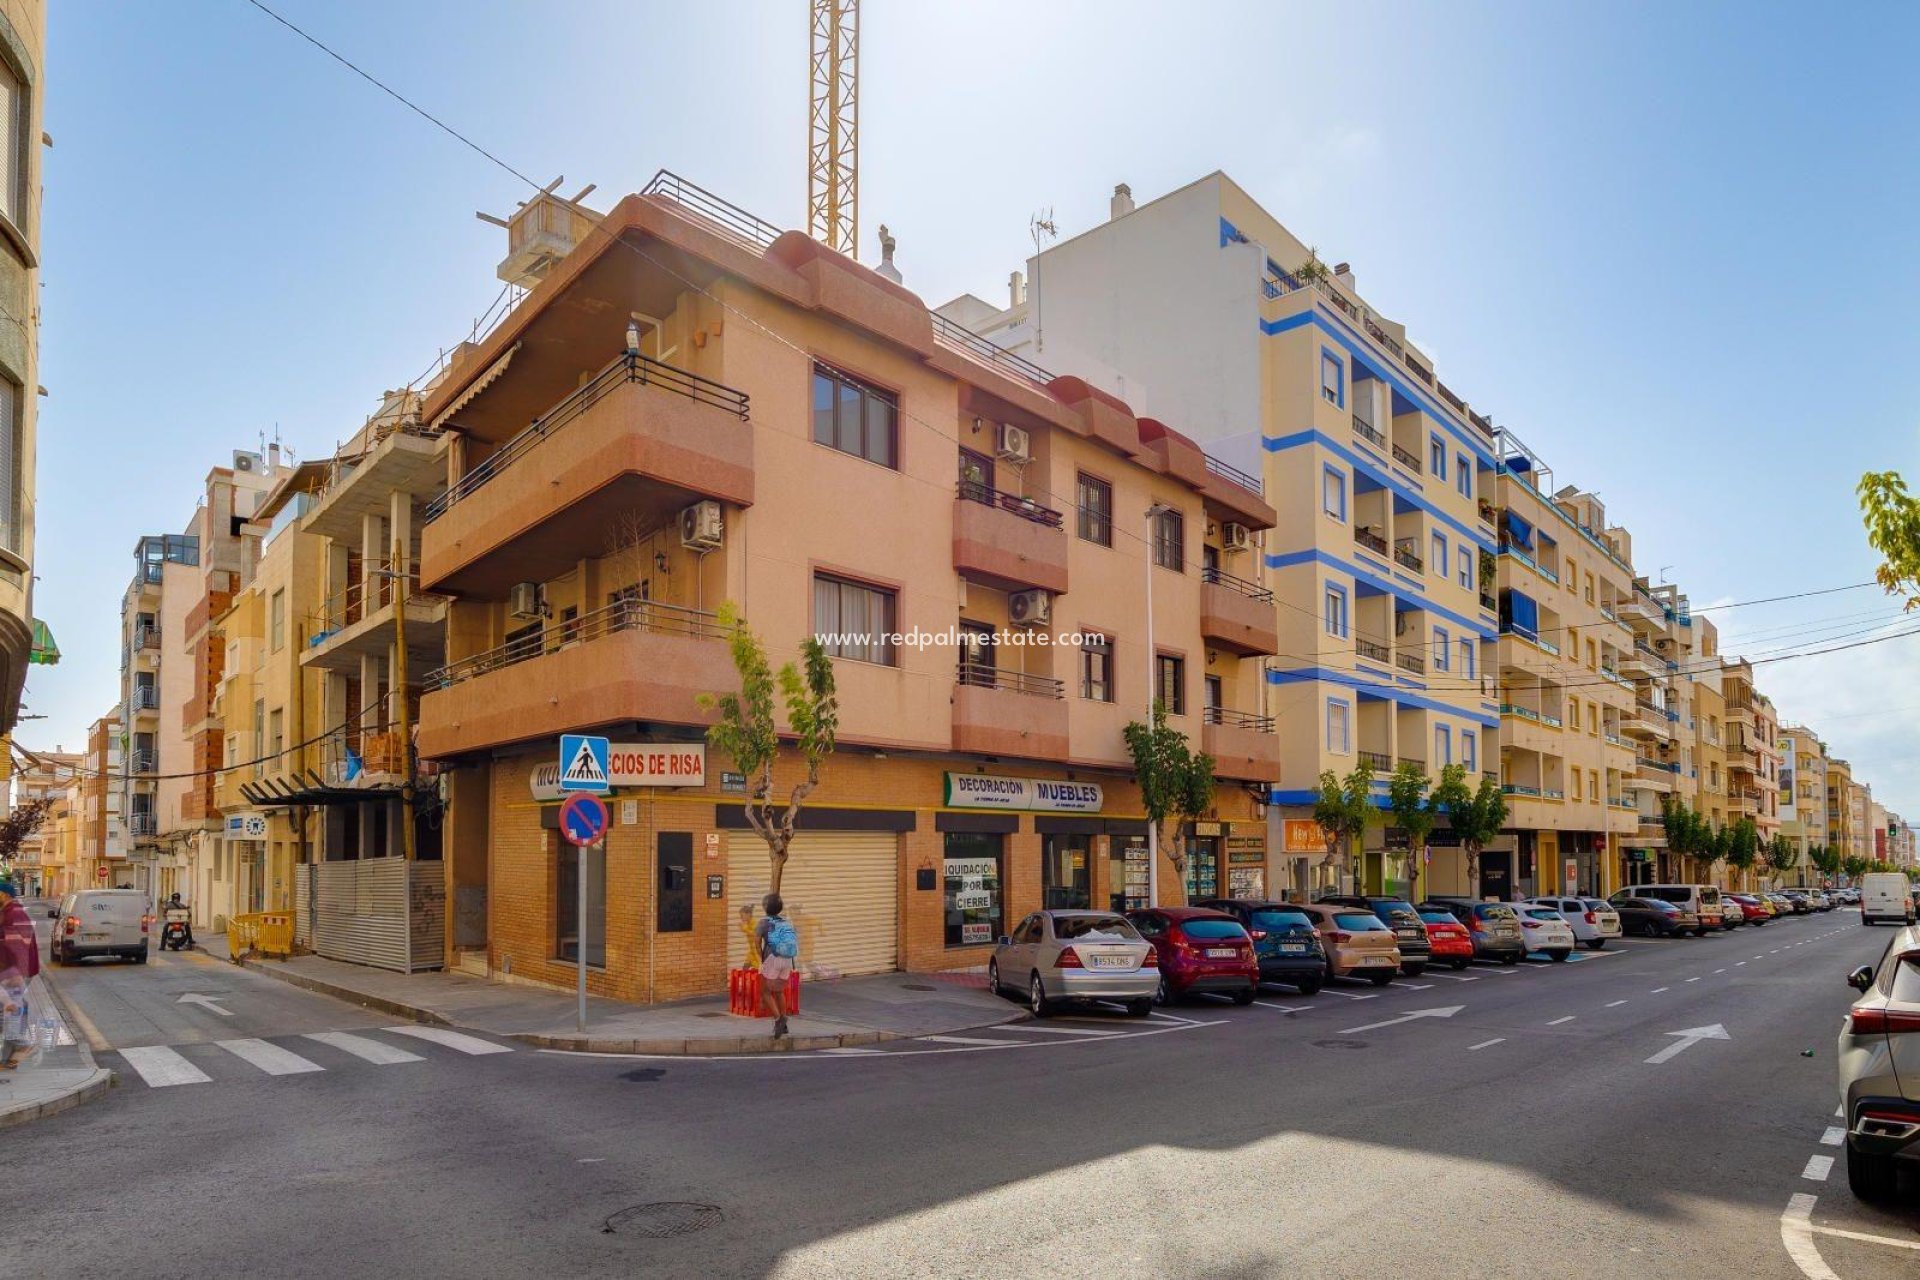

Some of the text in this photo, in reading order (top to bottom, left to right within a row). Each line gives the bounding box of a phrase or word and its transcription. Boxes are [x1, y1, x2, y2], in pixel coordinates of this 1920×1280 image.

[649, 753, 665, 775] DE
[670, 753, 702, 775] RISA
[959, 777, 1023, 795] DECORACIÓN
[1037, 783, 1098, 803] MUEBLES
[945, 864, 996, 875] IQUIDACION
[963, 881, 981, 891] POR
[957, 896, 989, 909] CIERRE
